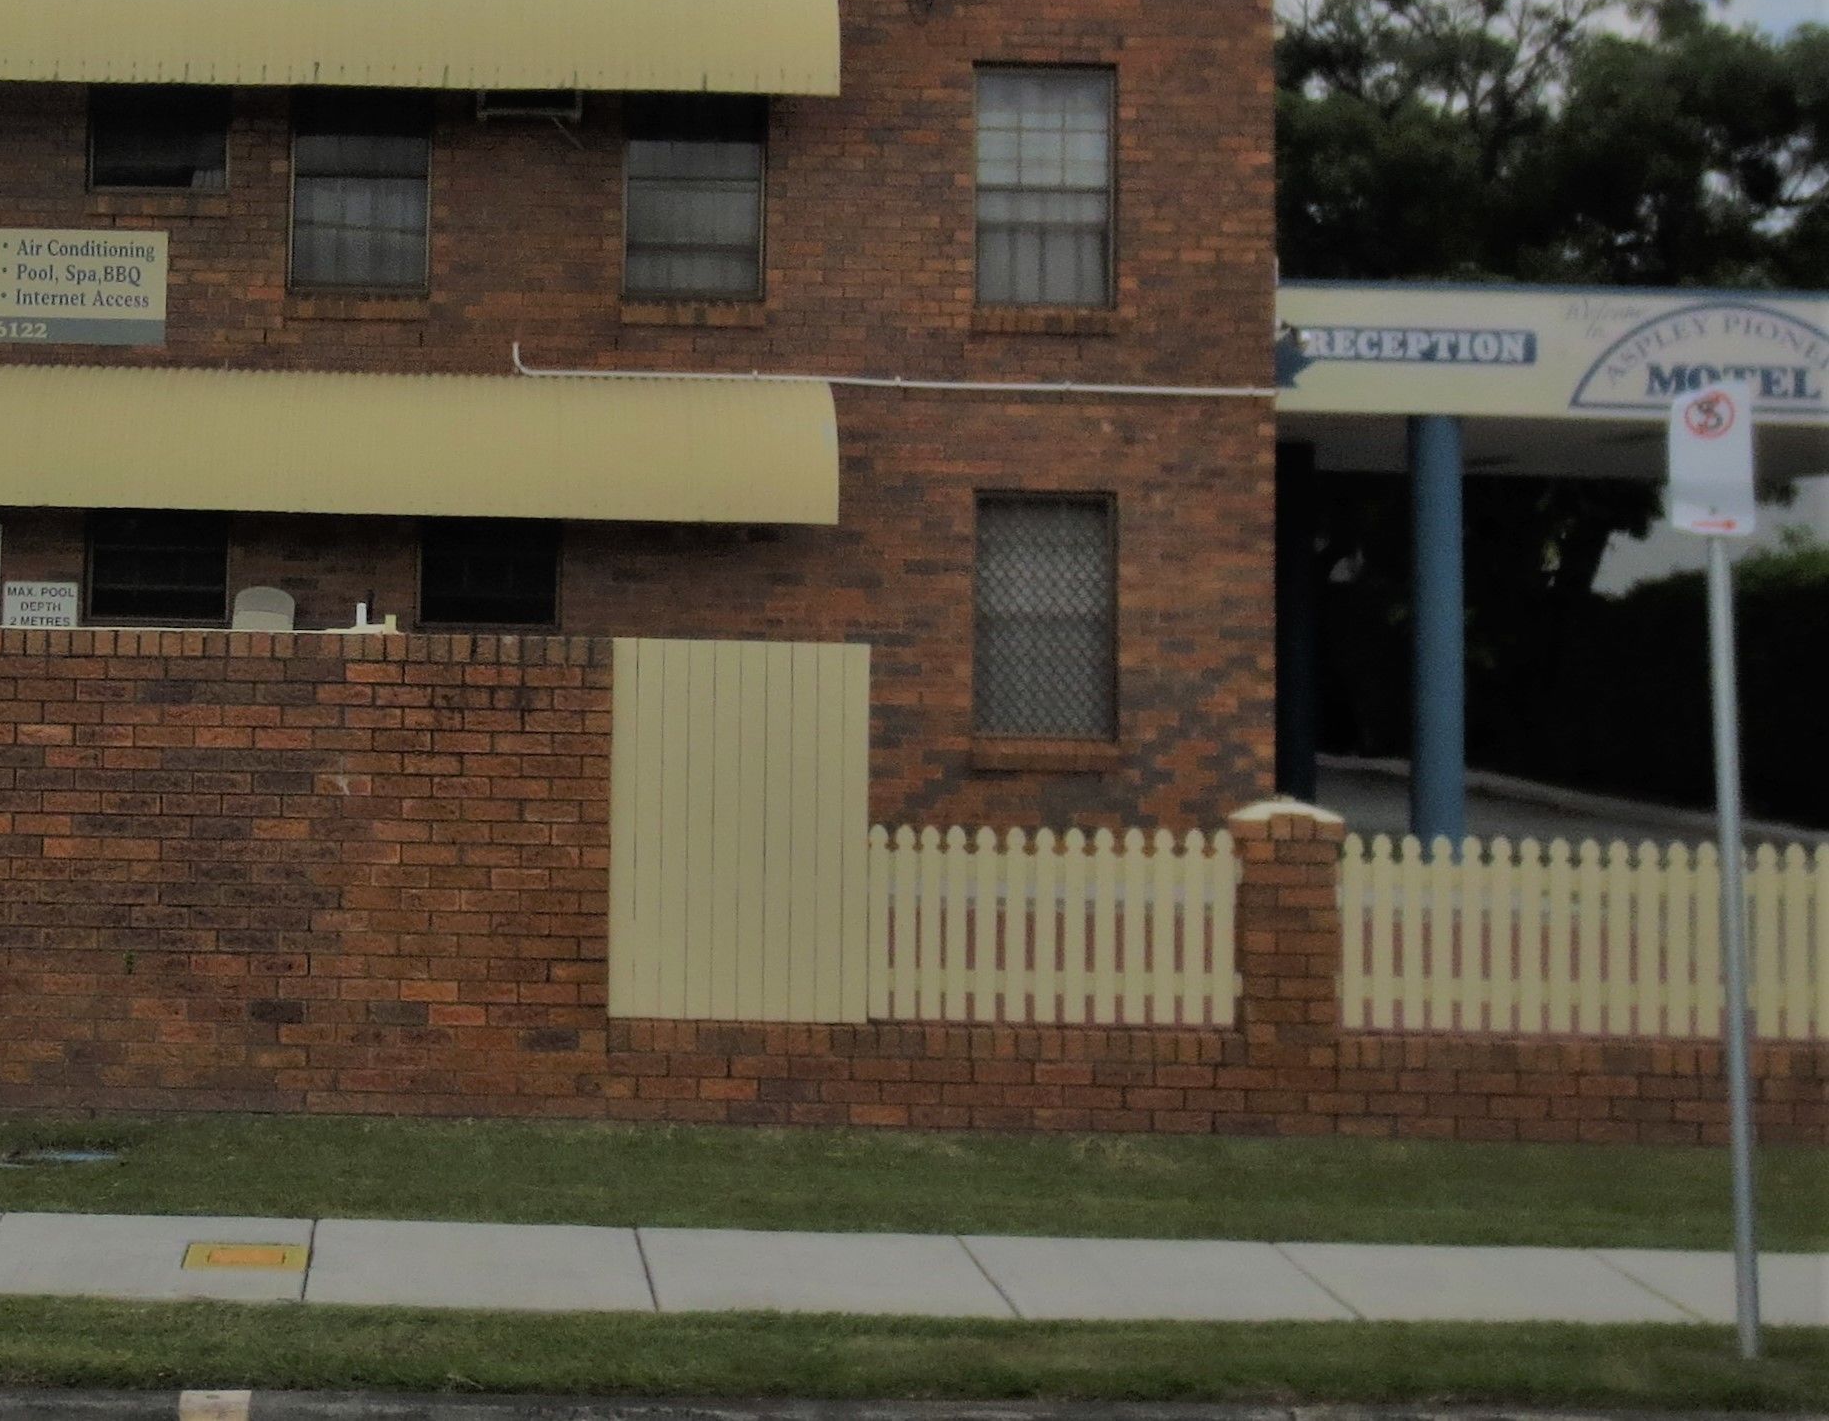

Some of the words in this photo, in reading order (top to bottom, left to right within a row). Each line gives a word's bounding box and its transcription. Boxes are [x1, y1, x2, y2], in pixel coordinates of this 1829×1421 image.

[16, 239, 43, 256] Air
[47, 239, 155, 262] Conditioning
[16, 263, 59, 284] Pool,
[16, 289, 86, 306] Internet
[92, 290, 149, 308] Access
[1301, 328, 1526, 363] RECEPTION
[1724, 316, 1829, 370] PIONE
[7, 587, 36, 596] MAX.
[40, 587, 75, 597] POOL
[20, 601, 61, 612] DEPTH
[10, 616, 17, 626] 2
[21, 616, 71, 627] METRES
